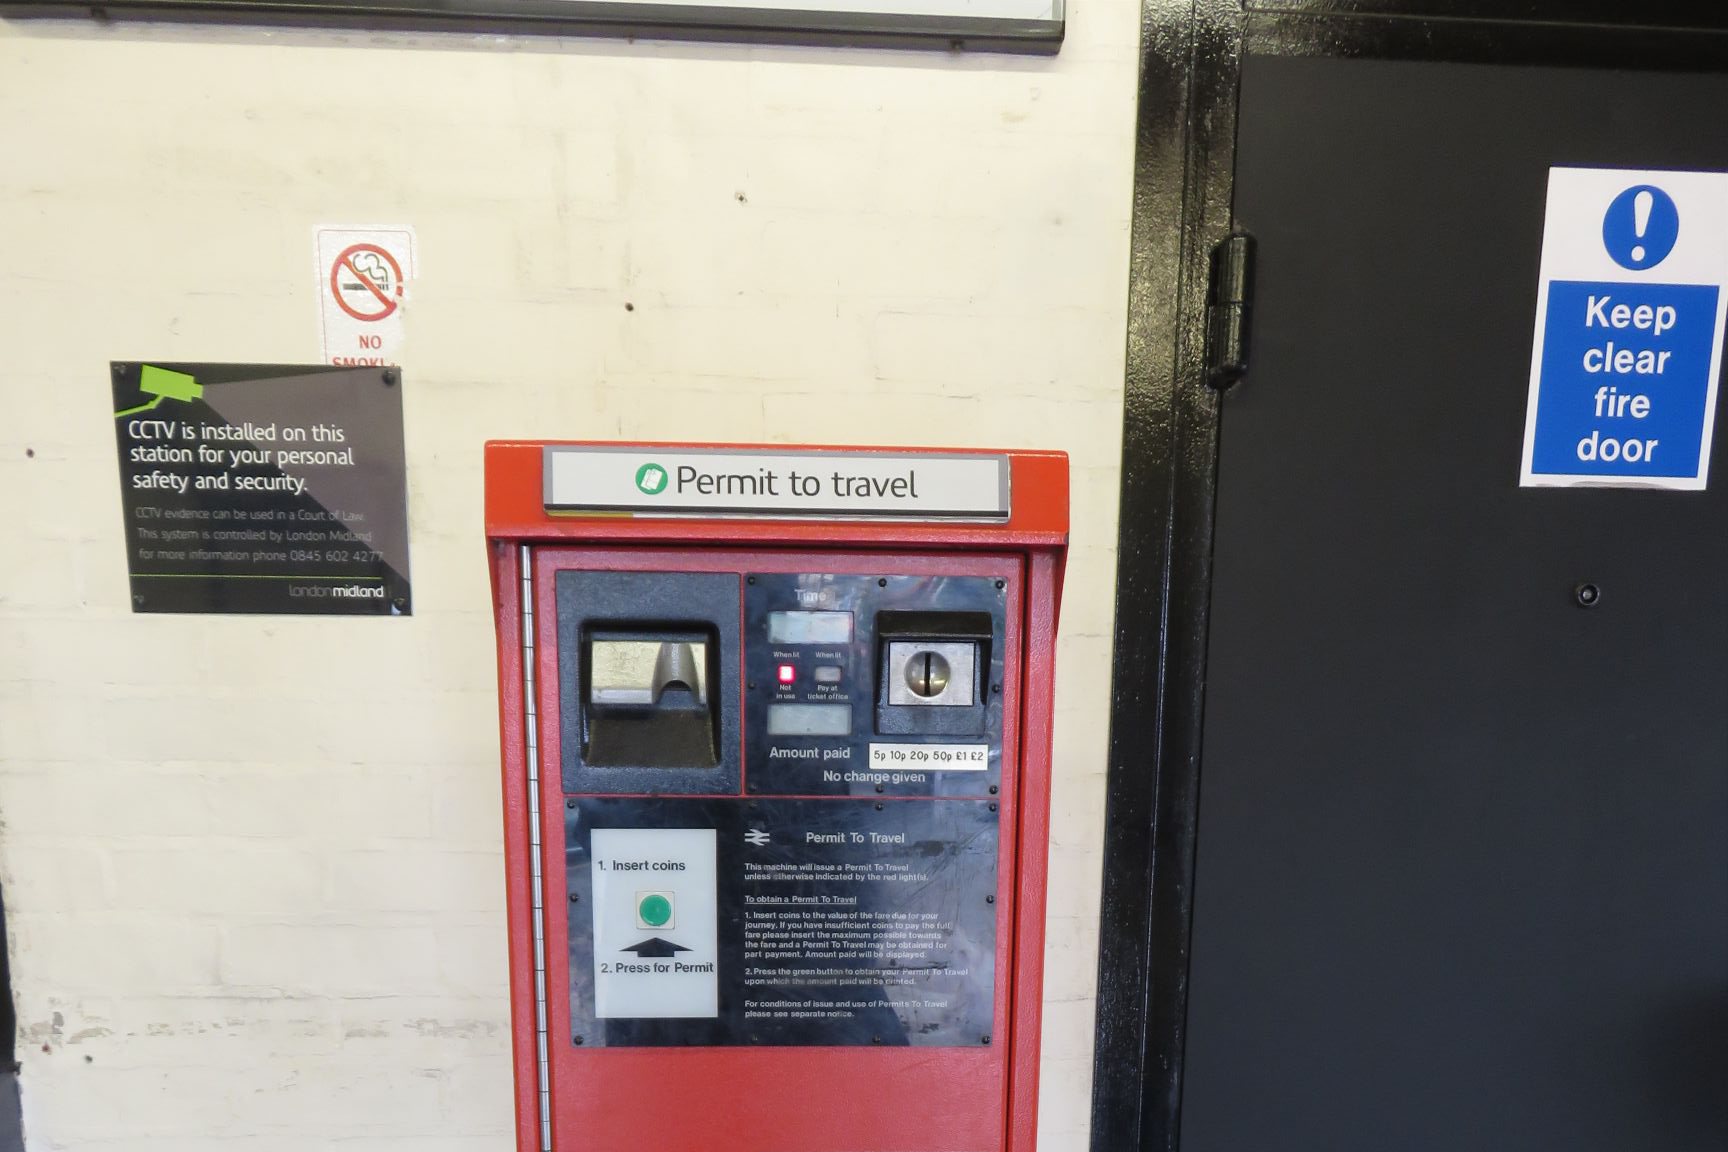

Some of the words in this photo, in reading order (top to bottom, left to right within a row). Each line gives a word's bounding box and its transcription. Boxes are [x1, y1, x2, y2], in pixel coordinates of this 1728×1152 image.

[1585, 296, 1676, 335] Keep
[359, 335, 382, 349] NO
[1583, 342, 1671, 374] clear
[1594, 386, 1650, 418] fire
[129, 420, 175, 440] CCTV
[182, 422, 195, 441] is
[201, 422, 276, 441] installed
[283, 426, 306, 441] on
[312, 424, 344, 442] this
[1577, 431, 1658, 463] door
[130, 445, 192, 463] station
[199, 445, 224, 463] for
[230, 450, 271, 468] your
[277, 447, 354, 468] personal
[133, 470, 189, 493] safety
[195, 472, 228, 490] and
[235, 473, 308, 496] security.
[677, 465, 778, 496] Permit
[791, 471, 820, 497] to
[832, 470, 918, 499] travel
[136, 507, 161, 518] CCTV
[164, 508, 209, 519] evidence
[213, 510, 231, 519] can
[233, 509, 246, 520] be
[250, 509, 273, 520] used
[277, 510, 286, 520] in
[289, 512, 295, 520] a
[298, 509, 325, 520] Court
[328, 509, 340, 520] of
[138, 528, 158, 539] This
[161, 530, 198, 541] system
[202, 530, 209, 539] is
[213, 529, 266, 540] controlled
[269, 531, 282, 543] by
[286, 531, 326, 541] London
[330, 531, 371, 542] Midland
[138, 549, 153, 559] for
[158, 551, 185, 560] more
[189, 549, 249, 560] information
[253, 550, 287, 562] phone
[290, 551, 320, 562] 0845
[326, 551, 348, 562] 602
[353, 551, 383, 561] 4277
[794, 589, 827, 600] Time
[770, 746, 818, 759] Amount
[824, 746, 850, 762] paid
[874, 751, 886, 761] 5p
[890, 751, 906, 761] 10p
[910, 751, 929, 761] 20p
[933, 751, 952, 762] 50p
[955, 750, 968, 760] £1
[971, 750, 984, 761] £2
[823, 771, 840, 783] No
[844, 771, 890, 785] change
[892, 772, 925, 785] given
[806, 832, 845, 843] Permit
[850, 832, 864, 843] To
[869, 832, 905, 843] Travel
[598, 861, 606, 871] 1.
[612, 860, 648, 871] Insert
[651, 860, 685, 871] coins
[762, 932, 789, 940] please
[873, 932, 905, 940] possible
[838, 951, 857, 959] paid
[601, 963, 612, 974] 2.
[616, 962, 650, 973] Press
[653, 962, 671, 973] for
[675, 962, 714, 973] Permit
